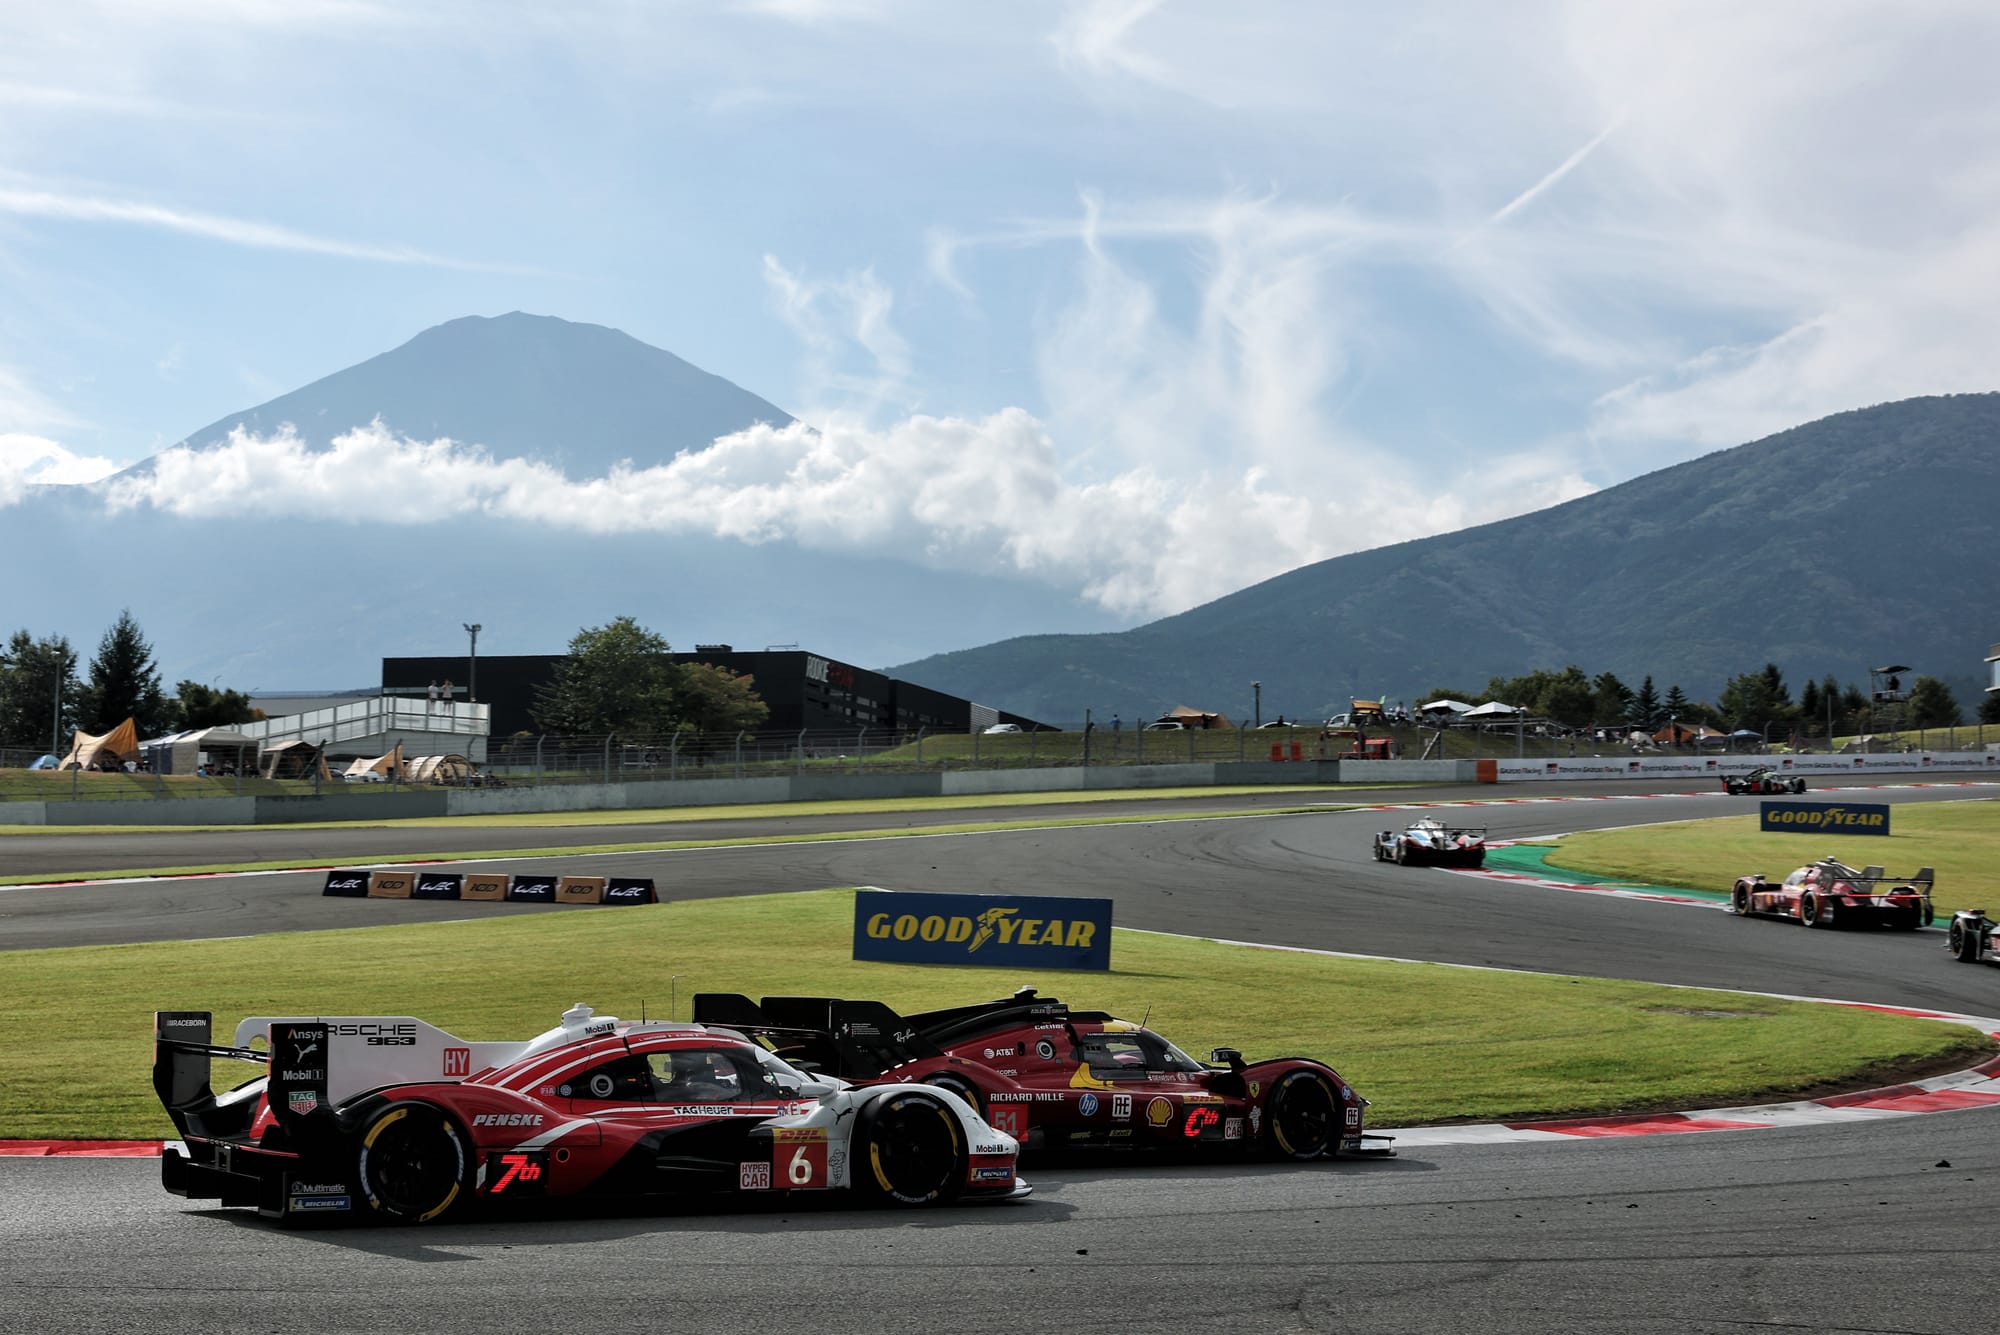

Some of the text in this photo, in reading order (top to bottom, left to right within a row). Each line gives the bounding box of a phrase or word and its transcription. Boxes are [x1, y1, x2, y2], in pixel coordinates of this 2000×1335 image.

[328, 880, 362, 888] WEC
[421, 882, 455, 891] WEC
[514, 884, 550, 894] WEC
[609, 887, 645, 896] WEC
[173, 1019, 207, 1027] RACEBORN
[328, 1025, 416, 1036] RSCHE
[584, 1024, 607, 1035] Mobil
[288, 1029, 324, 1041] Ansys
[367, 1037, 416, 1046] 963
[995, 1048, 1015, 1057] AT&T
[444, 1050, 468, 1074] HY
[282, 1070, 312, 1080] Mobil
[990, 1092, 1065, 1102] RICHARD MILLE
[1081, 1095, 1096, 1115] hp
[472, 1114, 544, 1127] PENSKE
[995, 1111, 1018, 1136] 51
[976, 1145, 996, 1153] Mobil
[742, 1164, 769, 1173] HYPER
[789, 1145, 812, 1185] 6
[490, 1154, 541, 1193] 7th
[742, 1174, 769, 1187] CAR
